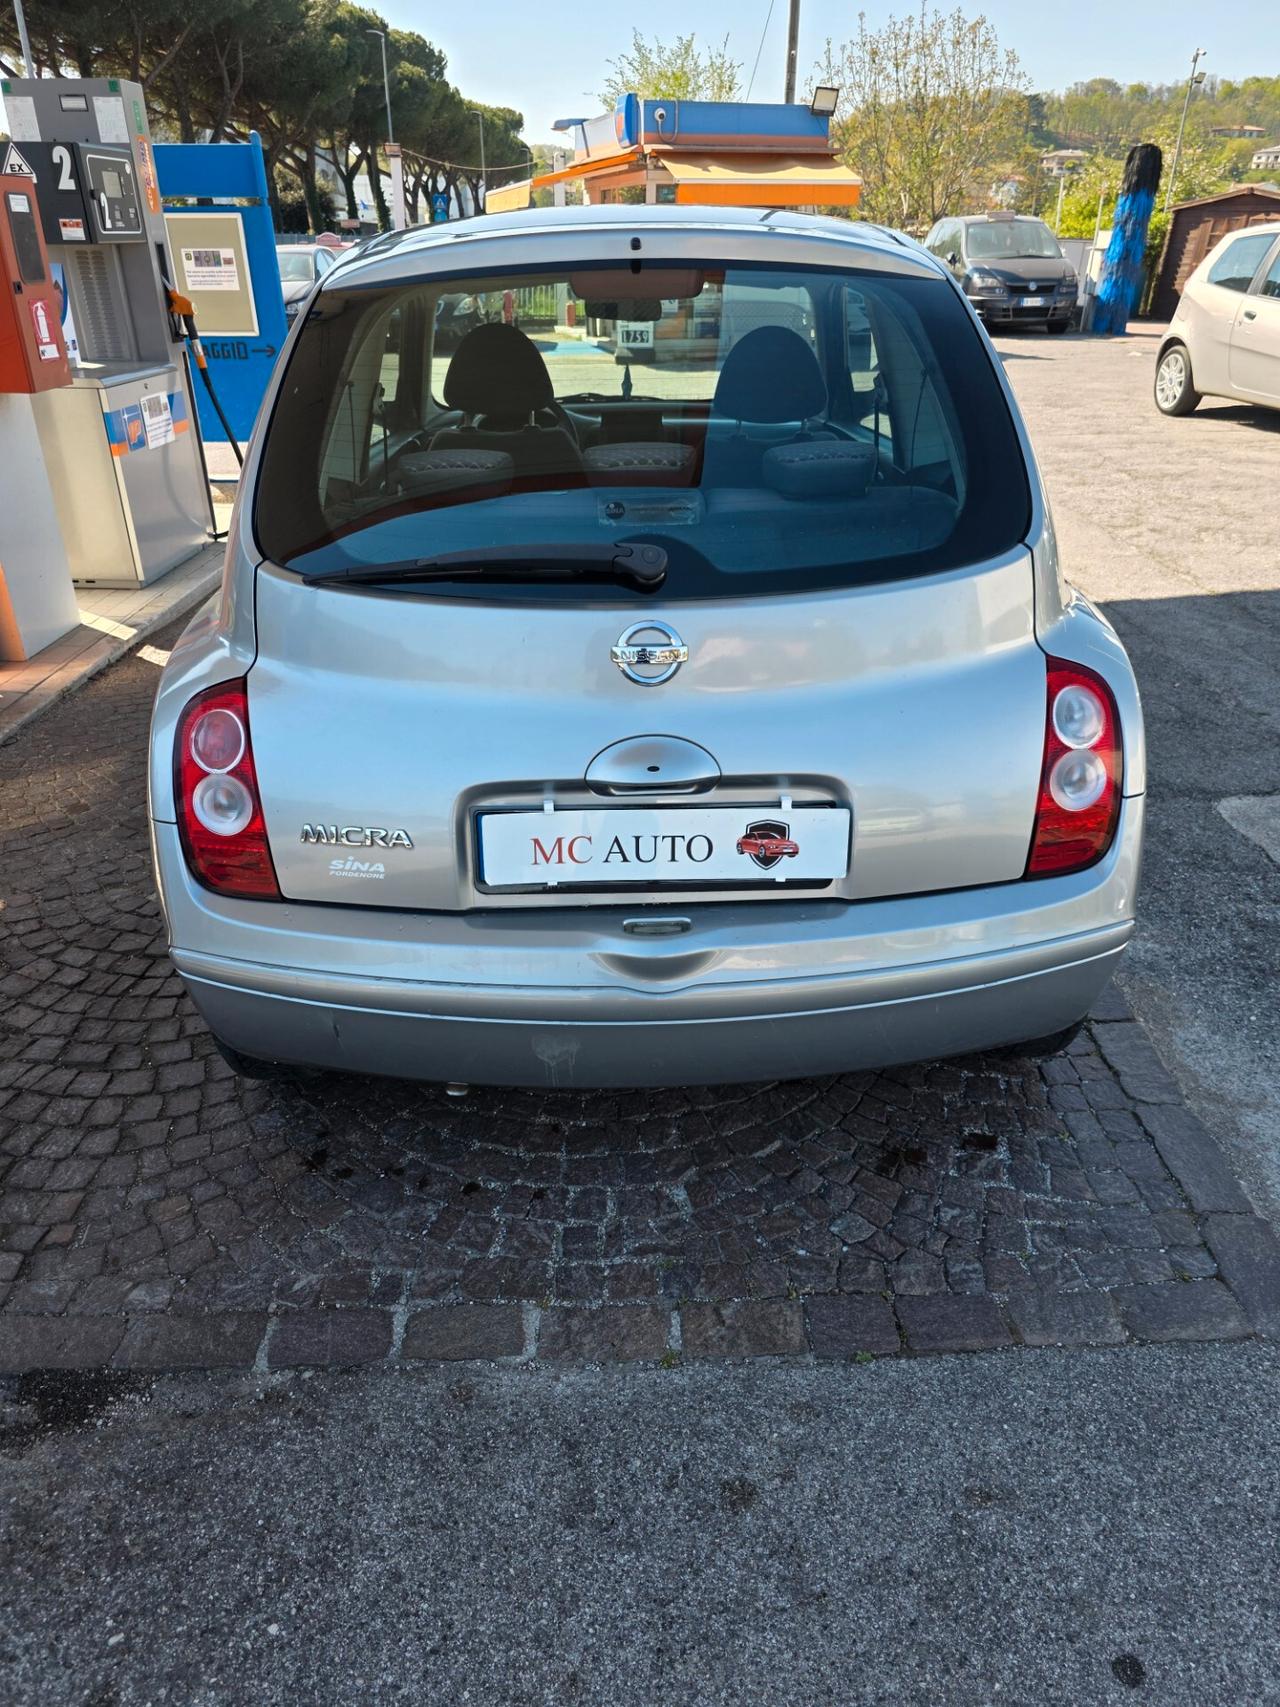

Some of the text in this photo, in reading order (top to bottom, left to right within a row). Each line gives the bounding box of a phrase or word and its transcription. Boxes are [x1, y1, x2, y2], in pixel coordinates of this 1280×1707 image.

[9, 163, 25, 173] EX
[52, 145, 76, 190] 2
[188, 341, 249, 360] AGGIO
[620, 648, 680, 661] NISSAN
[301, 823, 414, 850] MICRA
[530, 834, 714, 865] MC AUTO
